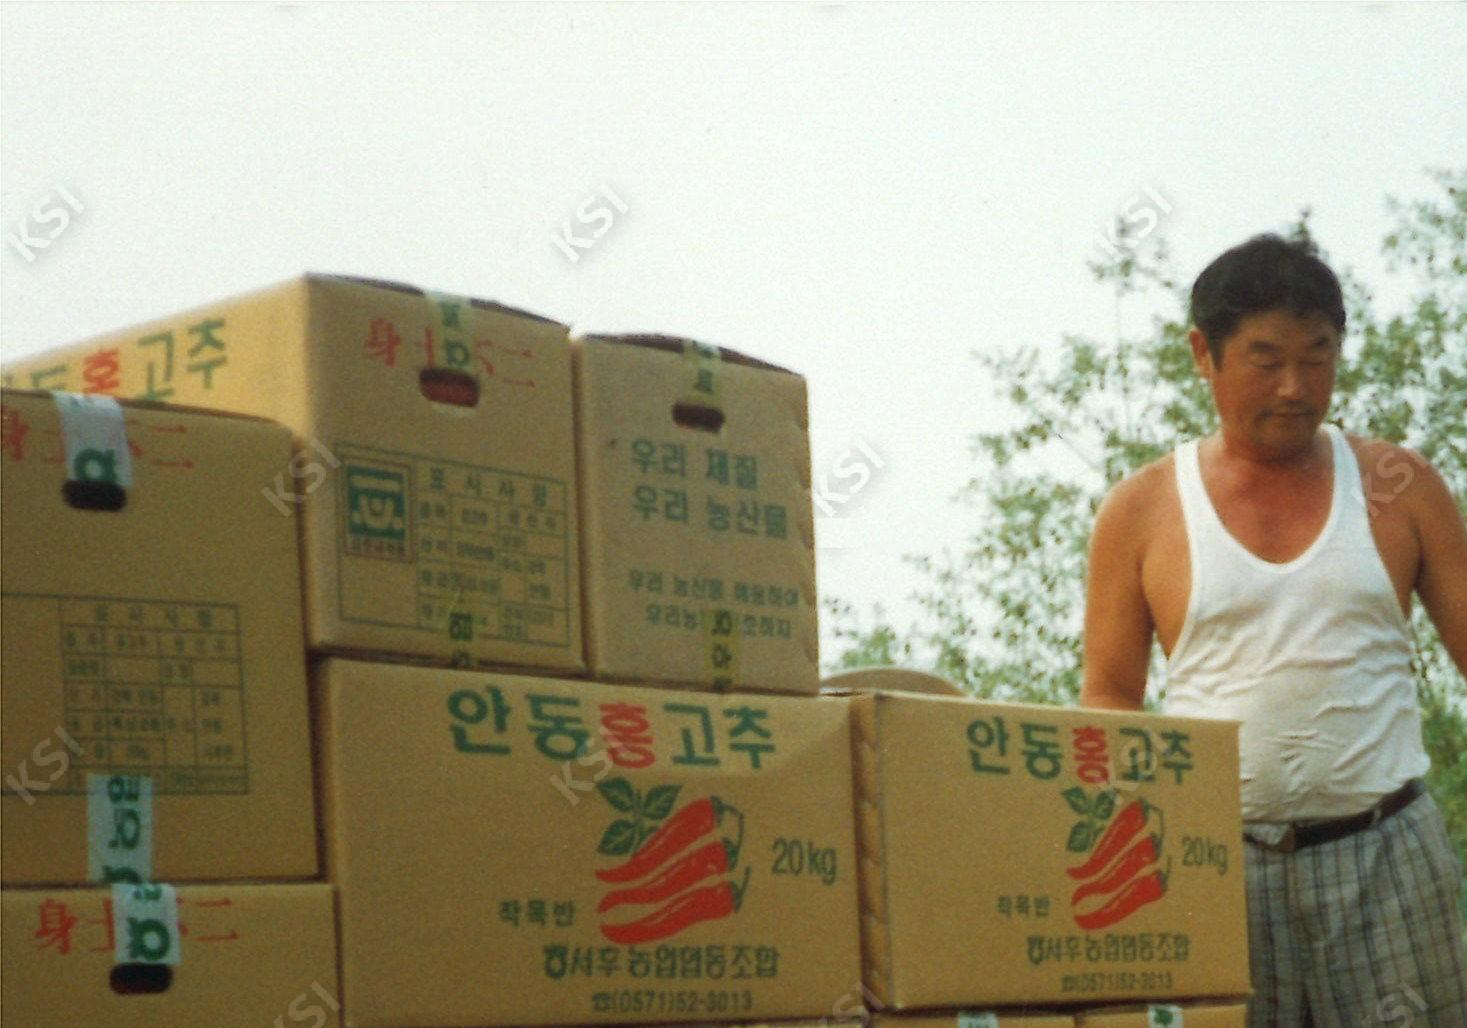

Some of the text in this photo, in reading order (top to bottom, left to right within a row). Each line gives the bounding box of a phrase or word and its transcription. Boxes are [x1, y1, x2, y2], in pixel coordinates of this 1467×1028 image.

[632, 439, 687, 478] 우리
[634, 485, 689, 523] 우리
[447, 684, 776, 769] 안동홍고추
[967, 716, 1193, 784] 안동홍고추
[771, 837, 837, 886] 20kg
[1181, 836, 1229, 875] 20kg
